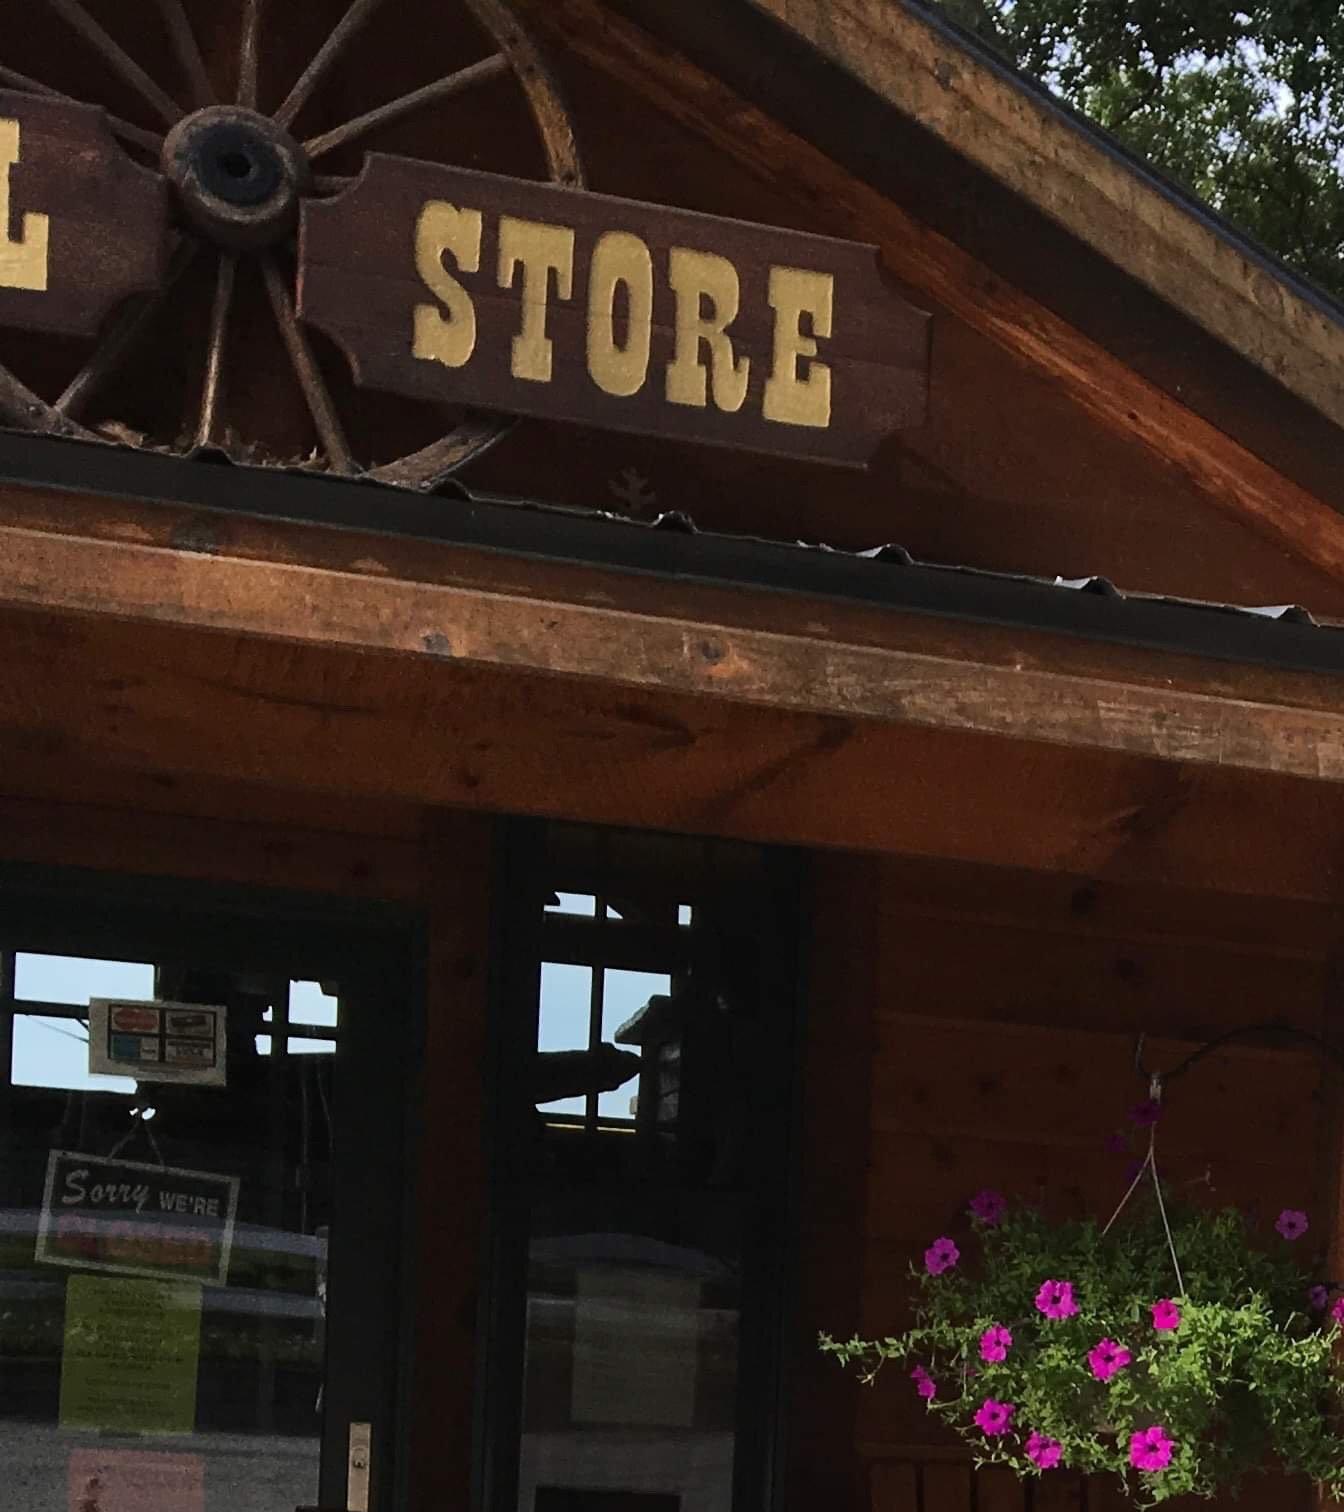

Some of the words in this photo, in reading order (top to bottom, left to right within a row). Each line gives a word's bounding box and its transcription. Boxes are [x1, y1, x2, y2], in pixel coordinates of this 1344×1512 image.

[411, 199, 835, 429] STORE
[62, 1169, 149, 1215] Sorry
[159, 1190, 219, 1217] WE'RE
